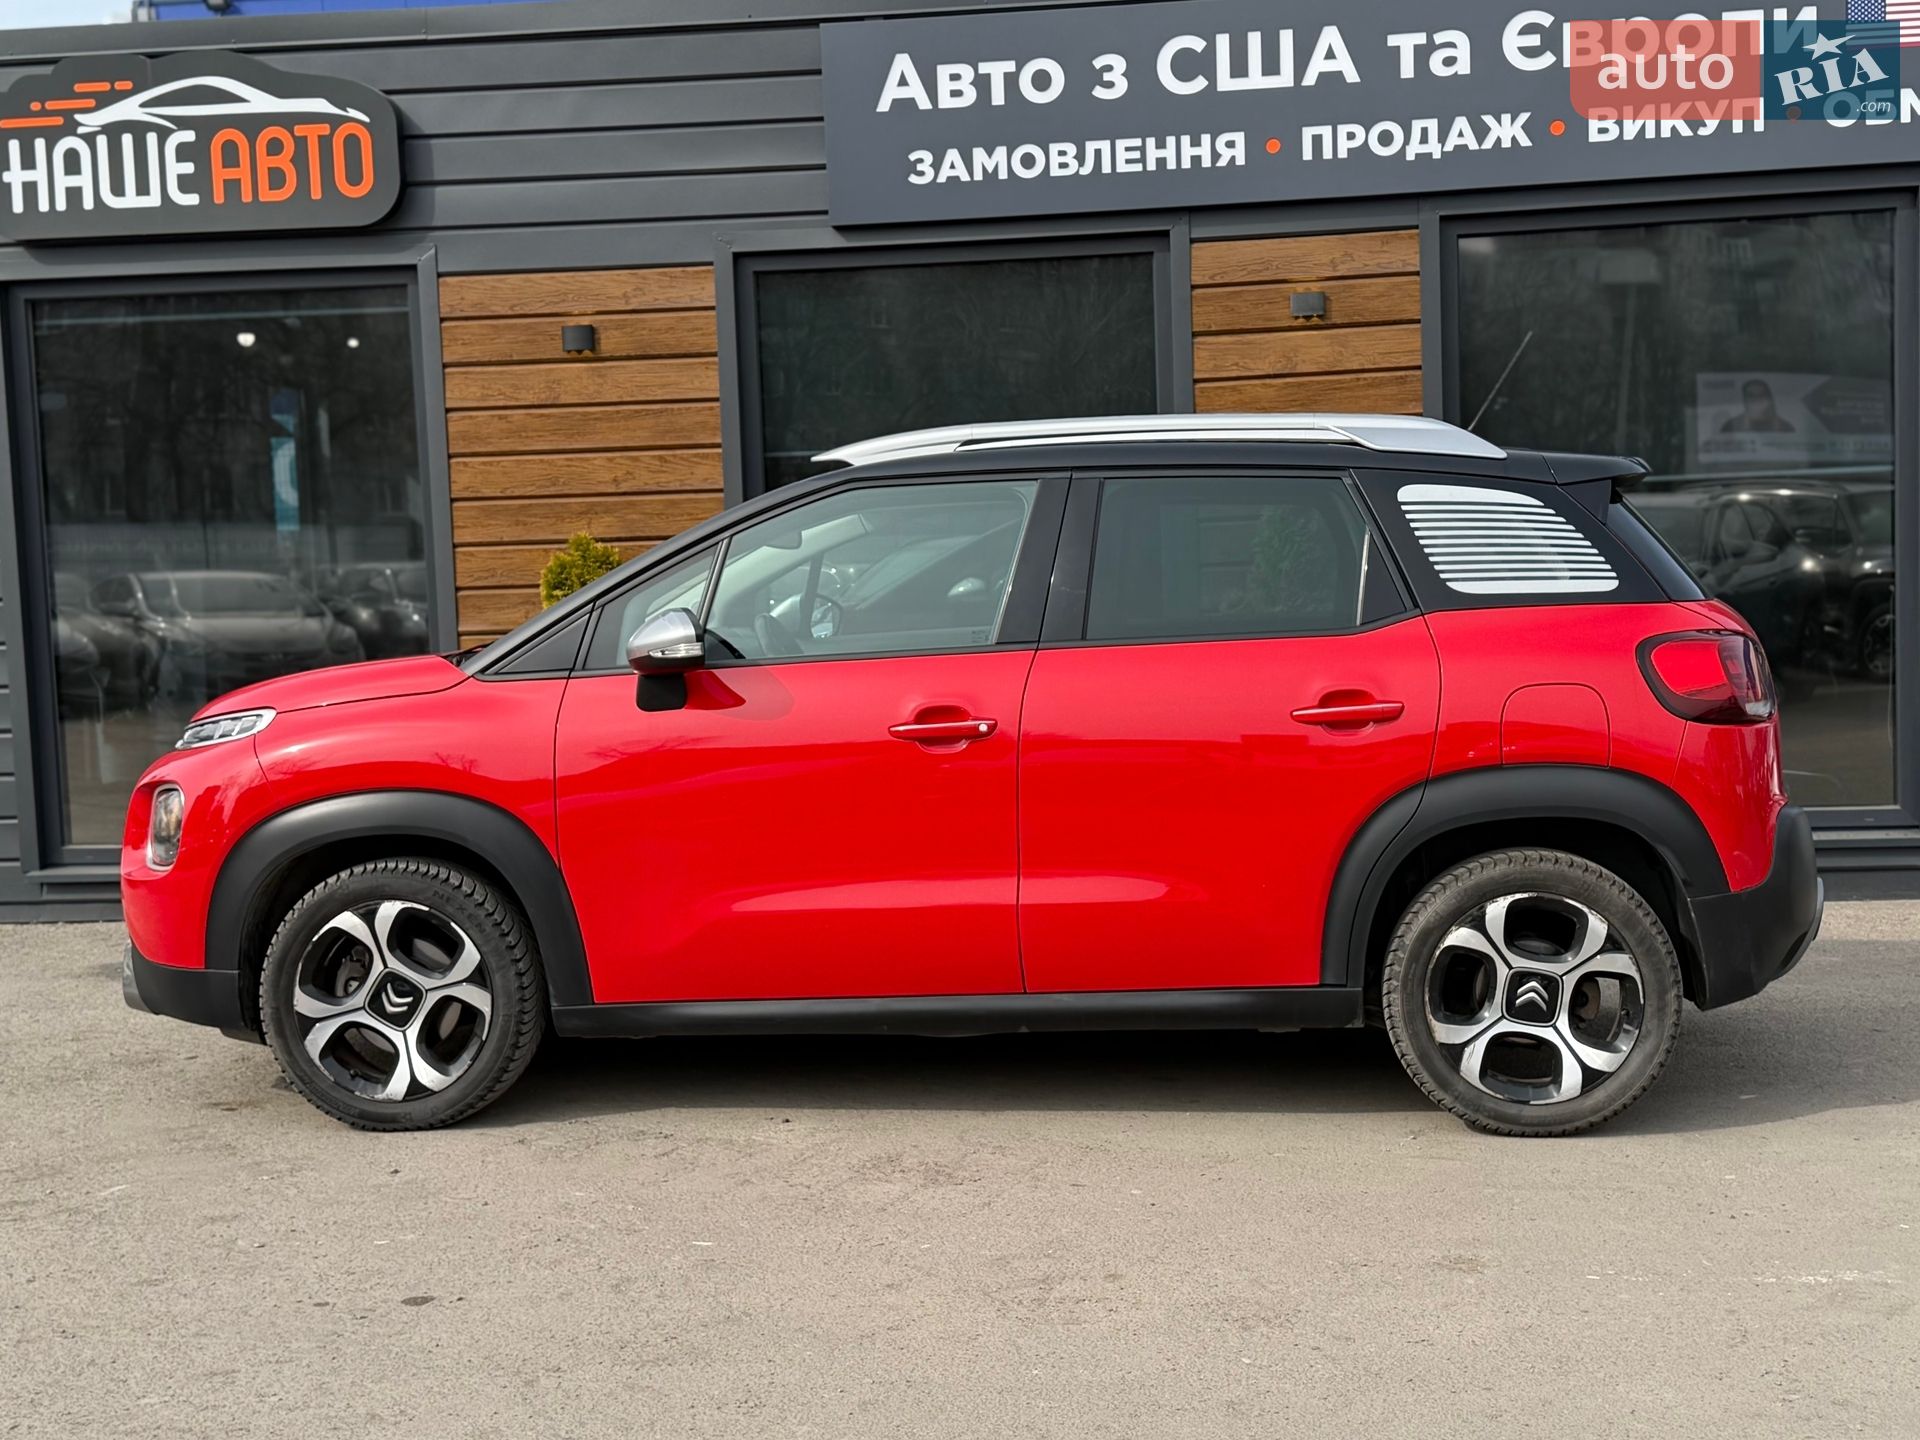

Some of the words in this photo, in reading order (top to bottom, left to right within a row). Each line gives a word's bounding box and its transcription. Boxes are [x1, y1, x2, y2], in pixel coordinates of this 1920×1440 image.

[876, 52, 1066, 112] Авто
[1091, 53, 1128, 100] з
[1156, 26, 1361, 95] США
[1387, 28, 1472, 79] та
[1501, 6, 1818, 77] Європи
[2, 130, 200, 214] НАШЕ
[210, 122, 375, 204] АВТО
[907, 131, 1246, 185] ЗАМОВЛЕННЯ
[1302, 111, 1533, 161] ПРОДАЖ
[1588, 96, 1765, 143] ВИКУП
